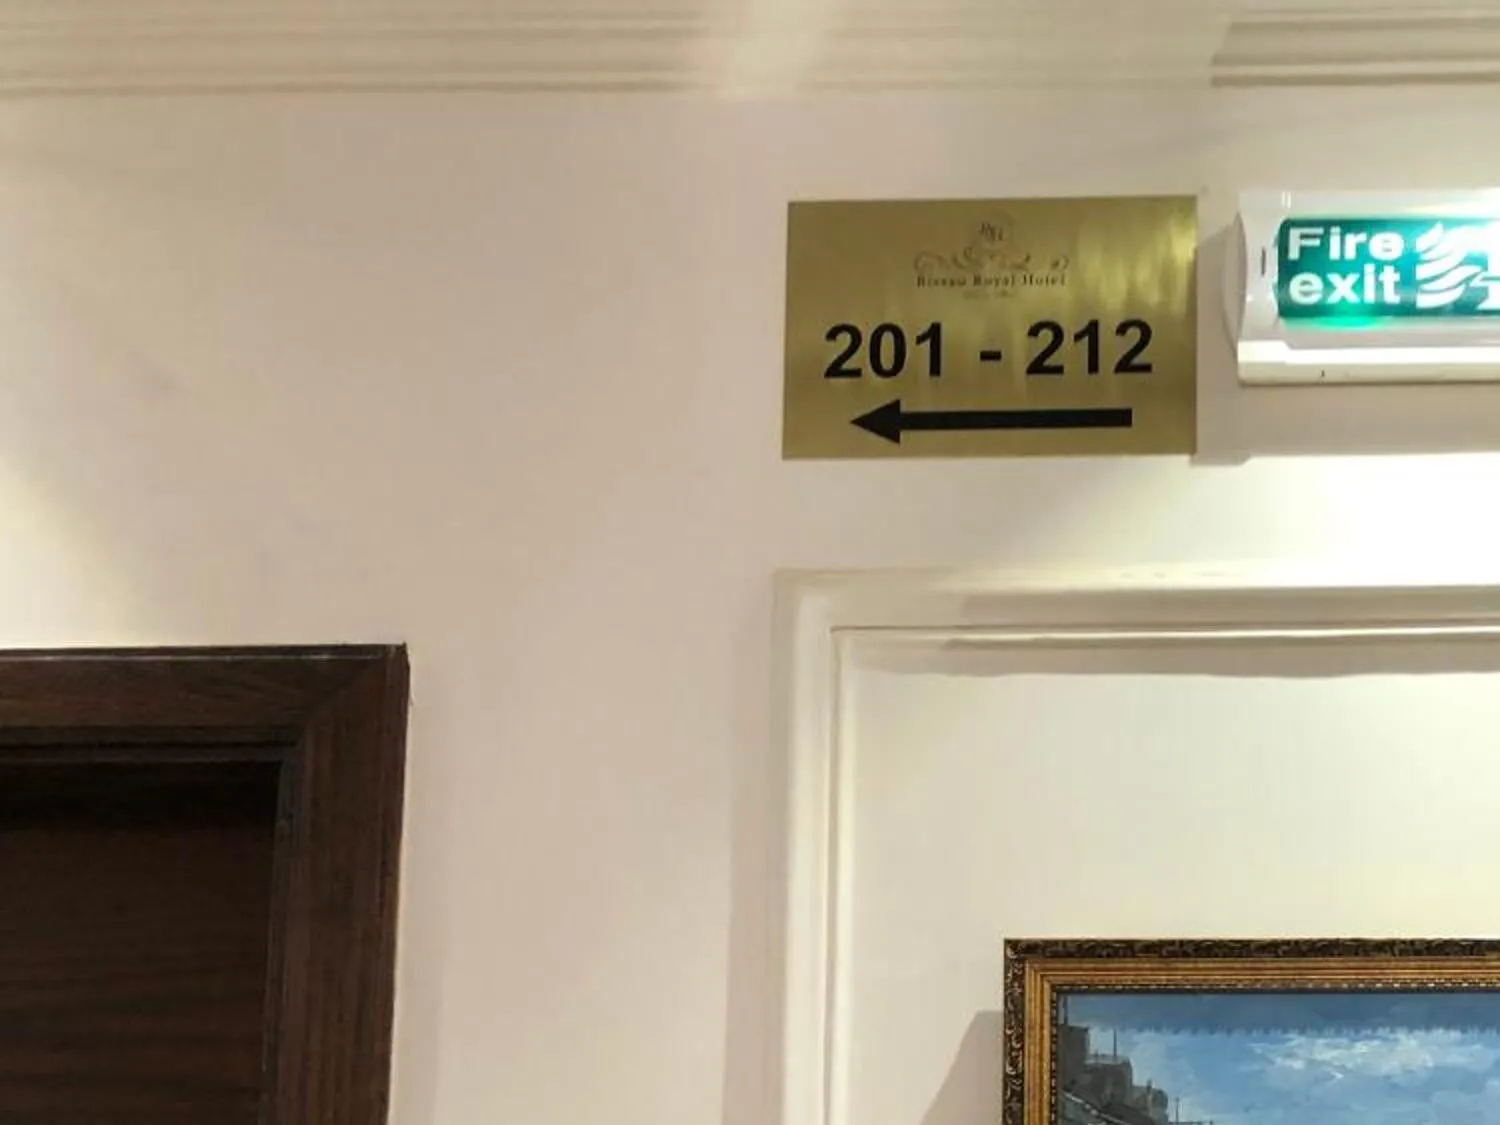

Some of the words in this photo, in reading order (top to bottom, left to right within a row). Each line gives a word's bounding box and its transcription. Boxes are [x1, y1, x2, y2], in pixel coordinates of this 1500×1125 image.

[1288, 226, 1405, 260] Fire
[973, 273, 1015, 288] Royal
[1023, 272, 1066, 287] Hotel
[1288, 262, 1400, 305] exit
[823, 321, 942, 378] 201
[979, 349, 1002, 362] -
[1025, 319, 1153, 375] 212
